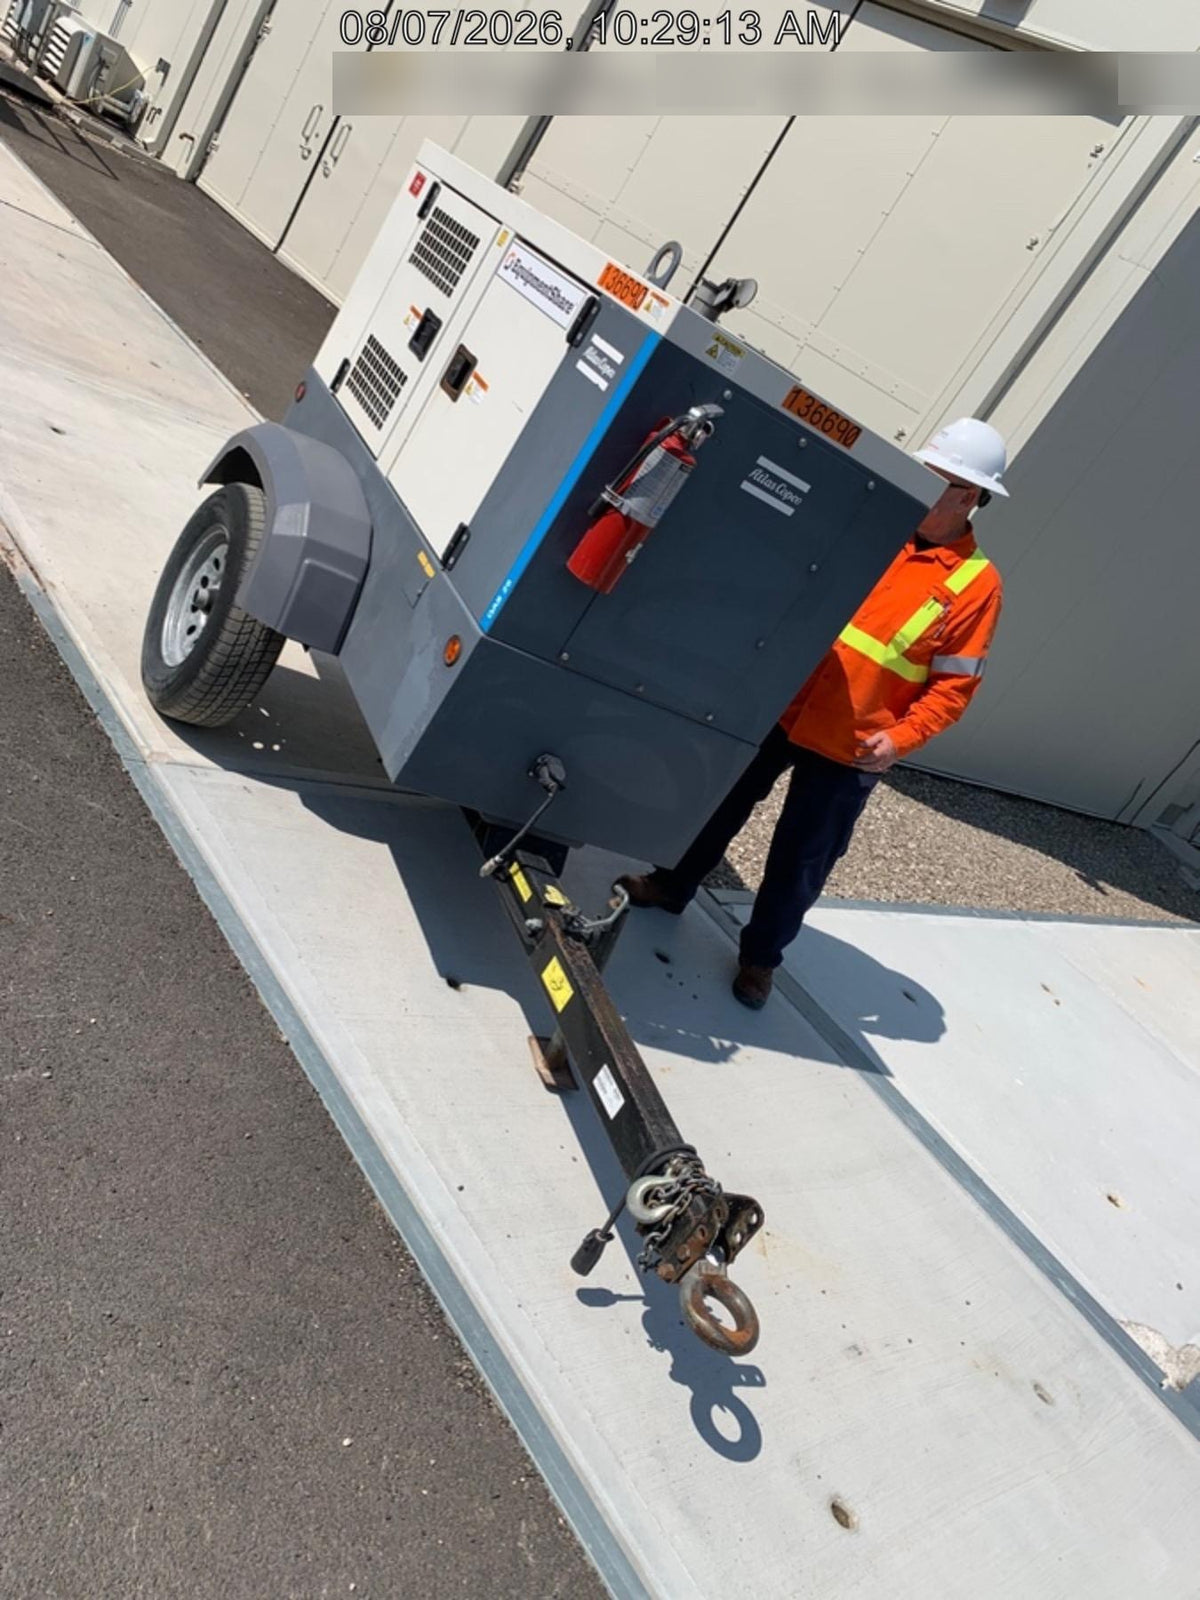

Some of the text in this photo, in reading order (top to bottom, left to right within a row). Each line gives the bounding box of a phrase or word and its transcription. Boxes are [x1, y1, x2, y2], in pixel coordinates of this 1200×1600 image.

[786, 389, 862, 449] 136690
[748, 468, 803, 506] Atlas Copco
